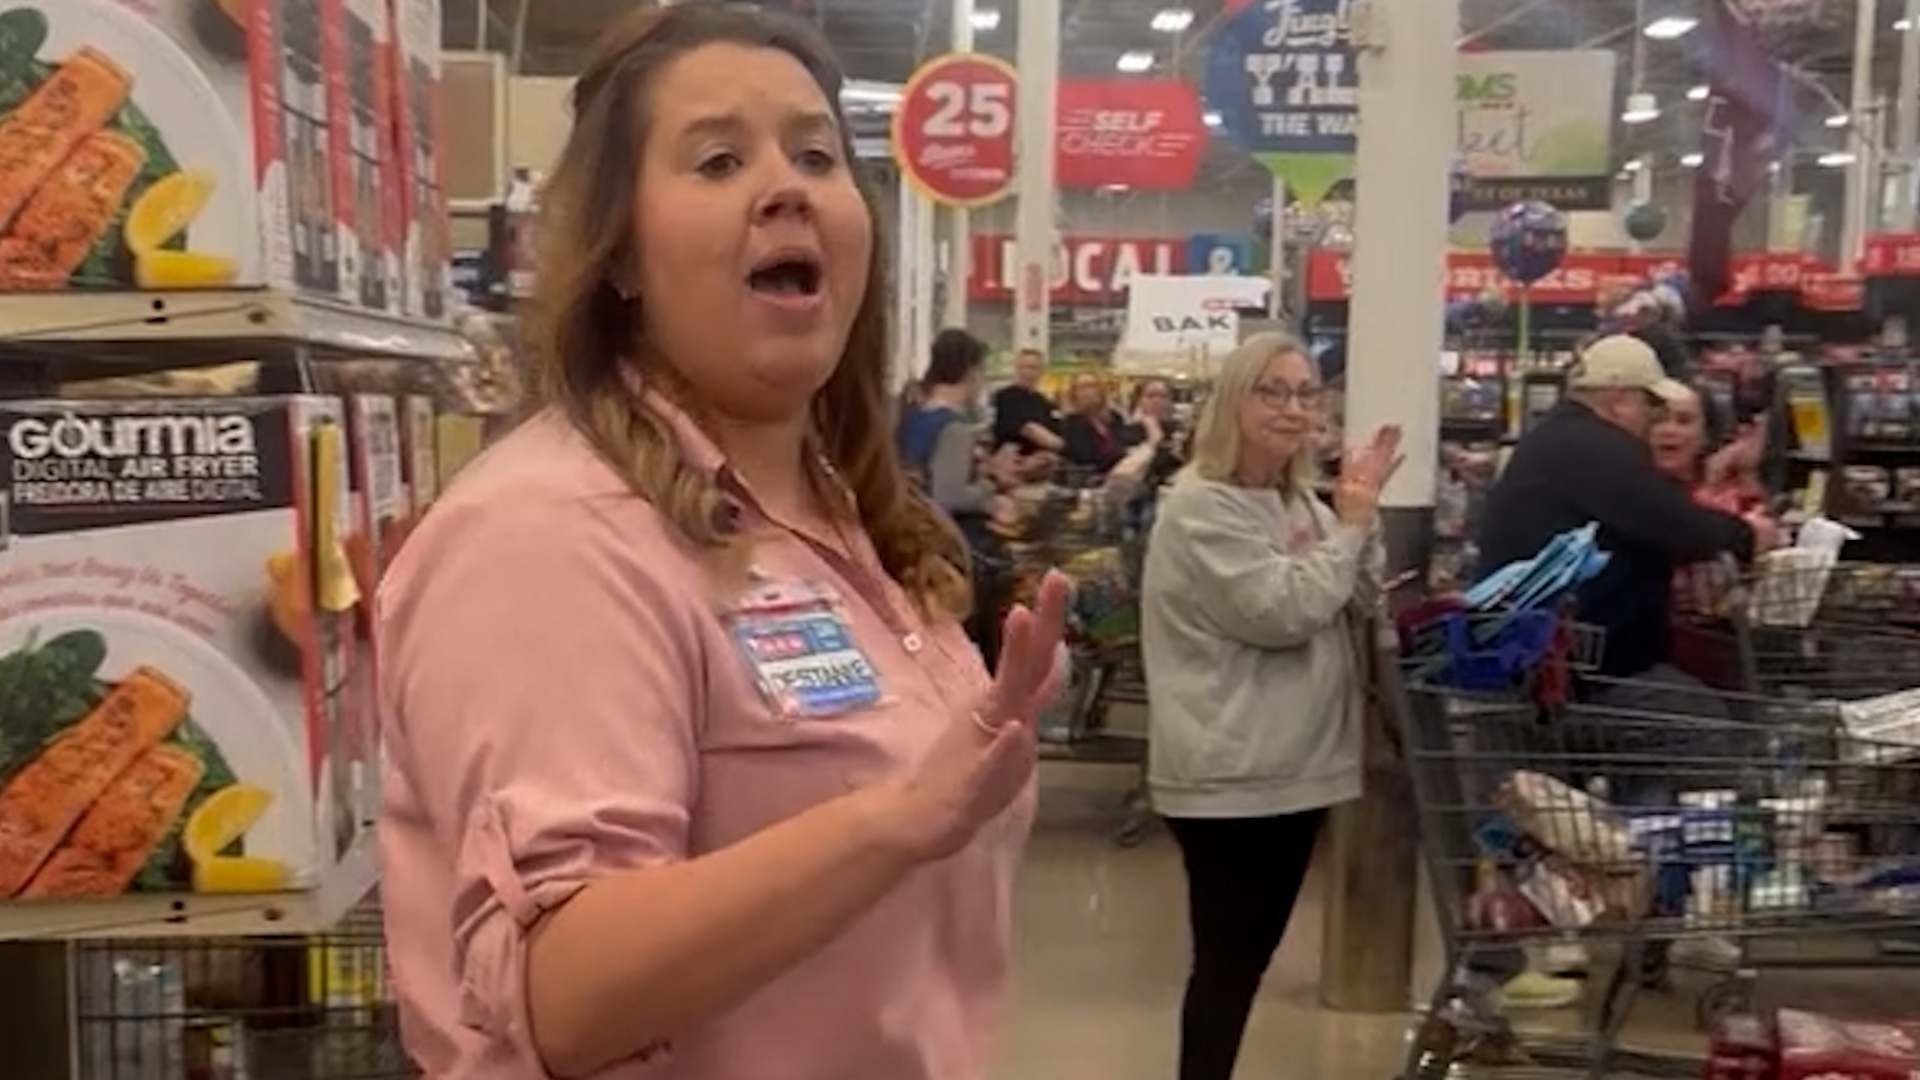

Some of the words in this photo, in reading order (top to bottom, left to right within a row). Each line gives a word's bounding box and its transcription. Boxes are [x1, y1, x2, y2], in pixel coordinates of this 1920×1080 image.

[923, 82, 1010, 137] 25
[1093, 109, 1165, 131] SELF
[1259, 112, 1309, 135] THE
[1060, 132, 1157, 156] CHECK
[1152, 316, 1231, 332] BAK
[13, 457, 114, 481] DIGITAL
[119, 456, 169, 478] AIR
[173, 454, 260, 478] FRYER
[113, 479, 142, 501] DE
[144, 478, 190, 501] AIRE
[191, 477, 263, 501] DIGITAL
